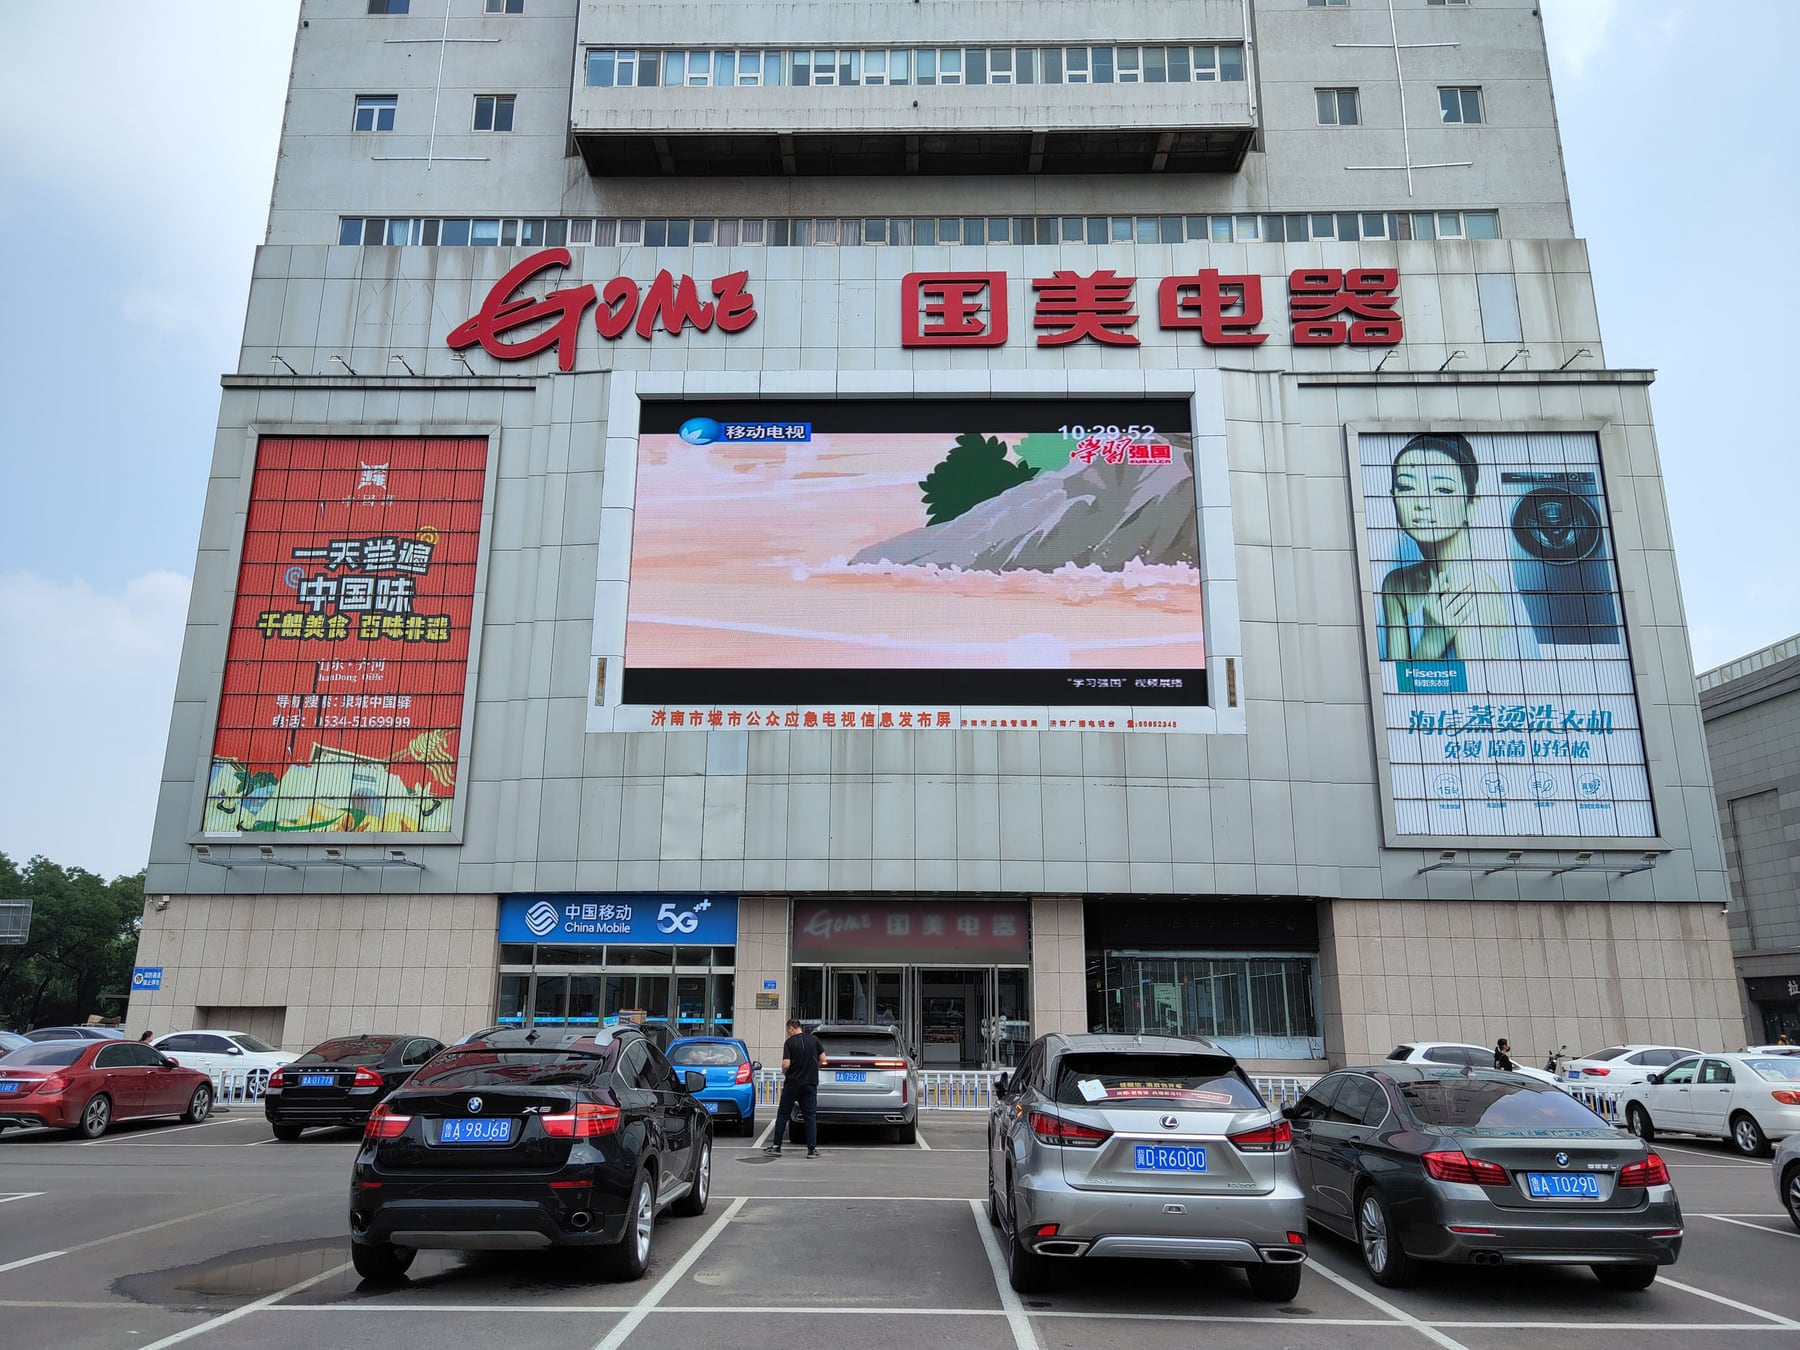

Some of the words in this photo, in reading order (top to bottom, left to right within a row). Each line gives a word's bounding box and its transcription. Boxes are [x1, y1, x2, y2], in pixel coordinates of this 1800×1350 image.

[902, 268, 1402, 347] 国美电器
[725, 425, 806, 439] 移动电视
[1058, 425, 1156, 440] 10:29:52
[294, 539, 432, 573] 一天尝遍
[299, 576, 415, 612] 中国味
[1405, 668, 1457, 678] Hisense
[651, 709, 951, 728] 济南市城市公众应急电视信息发布屏
[1408, 704, 1614, 736] 海信蒸烫洗衣机
[1444, 740, 1481, 758] 免熨
[1487, 740, 1526, 758] 除菌
[1533, 740, 1590, 758] 好轻松
[565, 903, 632, 921] 中国移动
[564, 922, 595, 934] China
[596, 922, 631, 934] Mobile
[886, 912, 1017, 936] 国美电器
